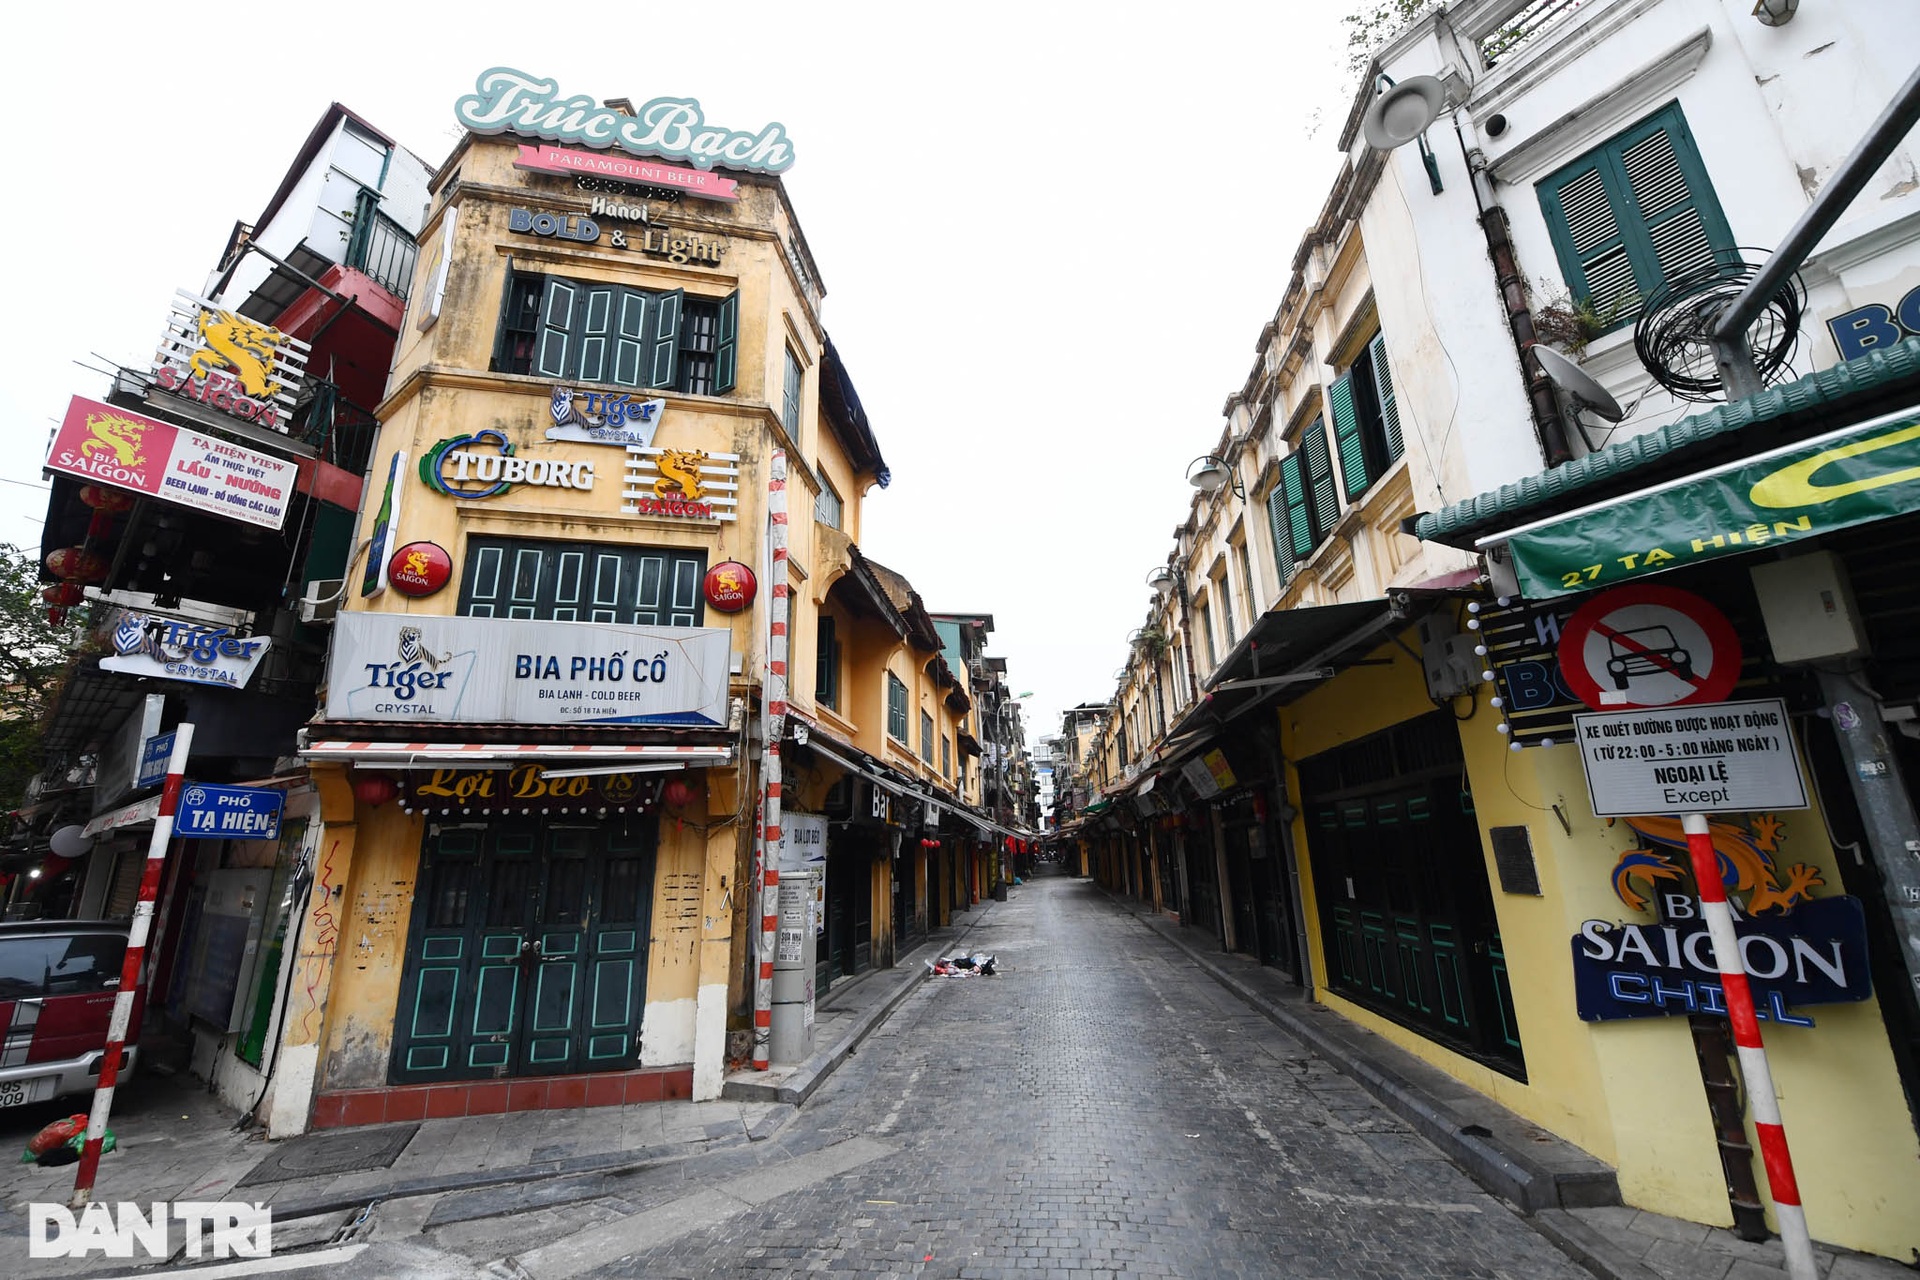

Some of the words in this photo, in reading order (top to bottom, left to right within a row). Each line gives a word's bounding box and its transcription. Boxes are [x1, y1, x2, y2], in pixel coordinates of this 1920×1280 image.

[461, 73, 617, 138] Trúc
[621, 103, 789, 167] Bạch
[550, 151, 660, 178] PARAMOUNT
[668, 169, 706, 186] BEER
[591, 196, 648, 222] Hanoi
[509, 208, 600, 242] BOLD
[611, 229, 628, 247] &
[643, 231, 721, 264] Light
[208, 371, 246, 395] BIA
[157, 368, 279, 427] SAIGON
[582, 392, 656, 427] Tiger
[589, 428, 643, 442] CRYSTAL
[93, 452, 119, 467] BIA
[192, 437, 210, 452] TẠ
[214, 444, 248, 460] HIỆN
[251, 456, 285, 472] VIEW
[58, 452, 146, 487] SAIGON
[452, 451, 595, 490] TUBORG
[165, 476, 187, 490] BEER
[187, 482, 209, 496] LẠNH
[264, 505, 281, 518] LOẠI
[225, 474, 282, 500] NƯỚNG
[638, 498, 712, 518] SAIGON
[1561, 563, 1603, 588] 27
[1617, 548, 1675, 569] TẠ
[1690, 515, 1812, 553] HIỆN
[395, 572, 429, 586] SAIGON
[714, 591, 744, 602] SAIGON
[162, 620, 262, 663] Tiger
[165, 662, 238, 682] CRYSTAL
[365, 661, 452, 700] Tiger
[515, 654, 560, 680] BIA
[570, 650, 628, 682] PHỐ
[633, 650, 669, 683] CỔ
[375, 703, 435, 715] CRYSTAL
[538, 689, 555, 699] BIA
[557, 690, 582, 701] LẠNH
[591, 690, 615, 701] COLD
[618, 691, 641, 701] BEER
[1585, 725, 1600, 739] XE
[1603, 721, 1630, 737] QUÉT
[1633, 718, 1673, 735] ĐƯỜNG
[1675, 717, 1708, 735] ĐƯỢC
[1711, 714, 1742, 731] HOẠT
[1744, 711, 1779, 730] ĐỘNG
[1701, 735, 1734, 755] HÀNG
[1738, 734, 1770, 752] NGÀY
[1654, 764, 1707, 786] NGOẠI
[1710, 760, 1729, 784] LỆ
[218, 793, 253, 807] PHỐ
[872, 784, 890, 819] Bar
[1663, 787, 1730, 806] Except
[192, 810, 216, 832] TẠ
[221, 809, 270, 833] HIỆN
[1664, 893, 1744, 921] BA
[1581, 920, 1848, 988] SAIGON
[1609, 971, 1815, 1029] CHIL
